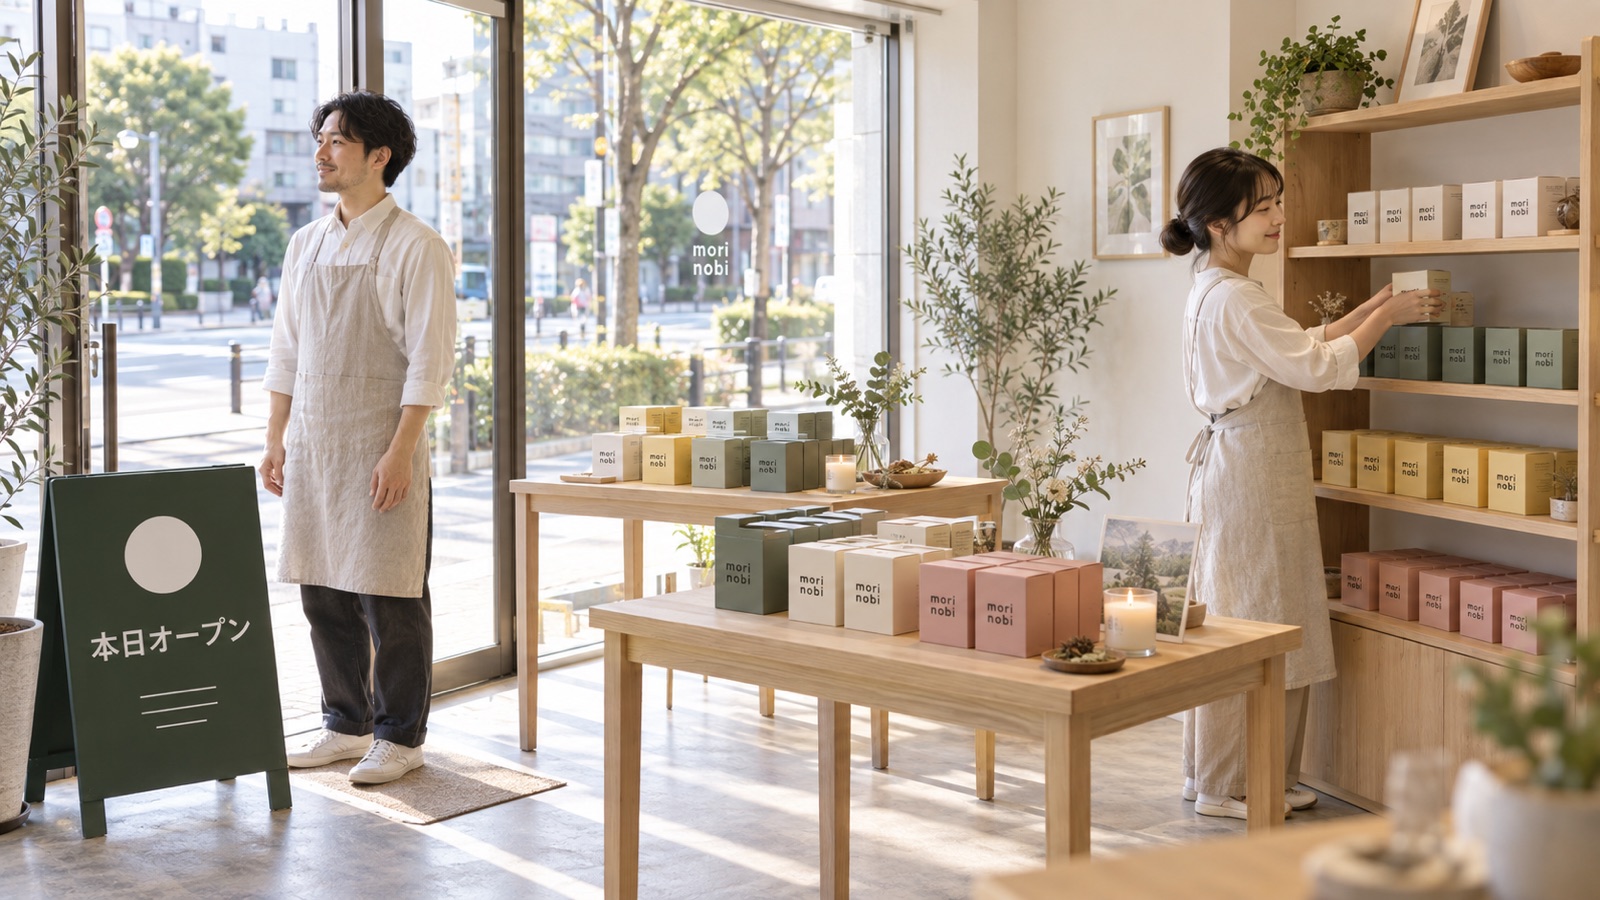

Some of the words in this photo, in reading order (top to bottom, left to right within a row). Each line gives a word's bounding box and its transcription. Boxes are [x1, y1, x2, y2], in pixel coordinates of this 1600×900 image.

[1510, 199, 1529, 207] mori
[1470, 210, 1487, 218] nobi
[1510, 208, 1528, 216] nobi
[693, 242, 729, 257] mori
[693, 260, 728, 276] nobi
[1452, 476, 1469, 484] nobi
[1496, 482, 1516, 491] nobi
[726, 563, 751, 573] mori
[726, 574, 751, 585] nobi
[800, 576, 824, 585] mori
[800, 586, 824, 596] nobi
[856, 583, 880, 594] mori
[856, 594, 880, 604] nobi
[930, 595, 955, 605] mori
[1426, 594, 1442, 602] mori
[987, 603, 1013, 614] mori
[1426, 601, 1442, 610] nobi
[1467, 604, 1484, 612] mori
[930, 606, 955, 617] nobi
[1467, 612, 1484, 620] nobi
[987, 614, 1013, 626] nobi
[1510, 614, 1528, 624] mori
[1510, 623, 1528, 632] nobi
[91, 617, 250, 661] 本日オープン
